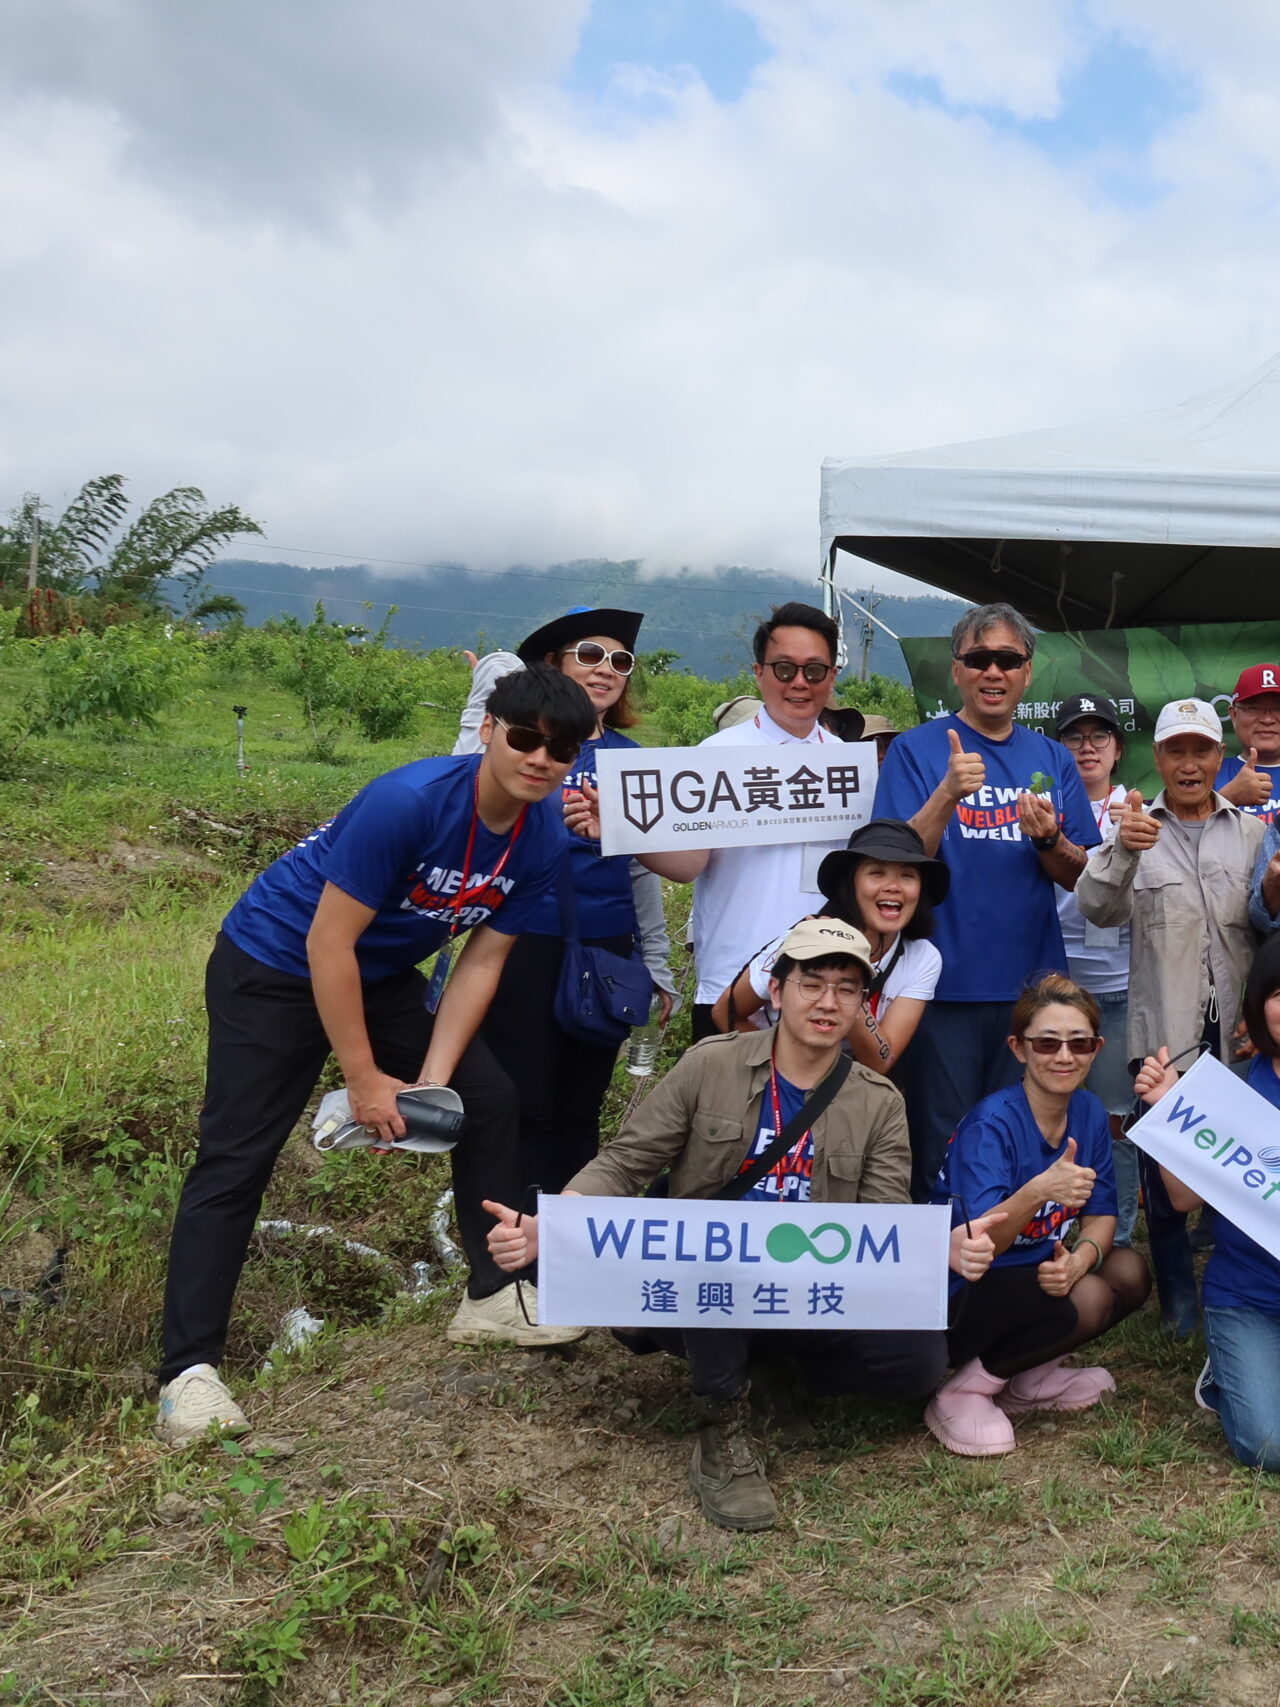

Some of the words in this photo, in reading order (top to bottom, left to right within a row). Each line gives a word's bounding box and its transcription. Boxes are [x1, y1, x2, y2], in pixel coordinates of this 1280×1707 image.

[1261, 669, 1279, 688] R
[1079, 698, 1096, 712] LA
[587, 1217, 901, 1265] WELBLOOM
[641, 1279, 846, 1316] 逢興生技
